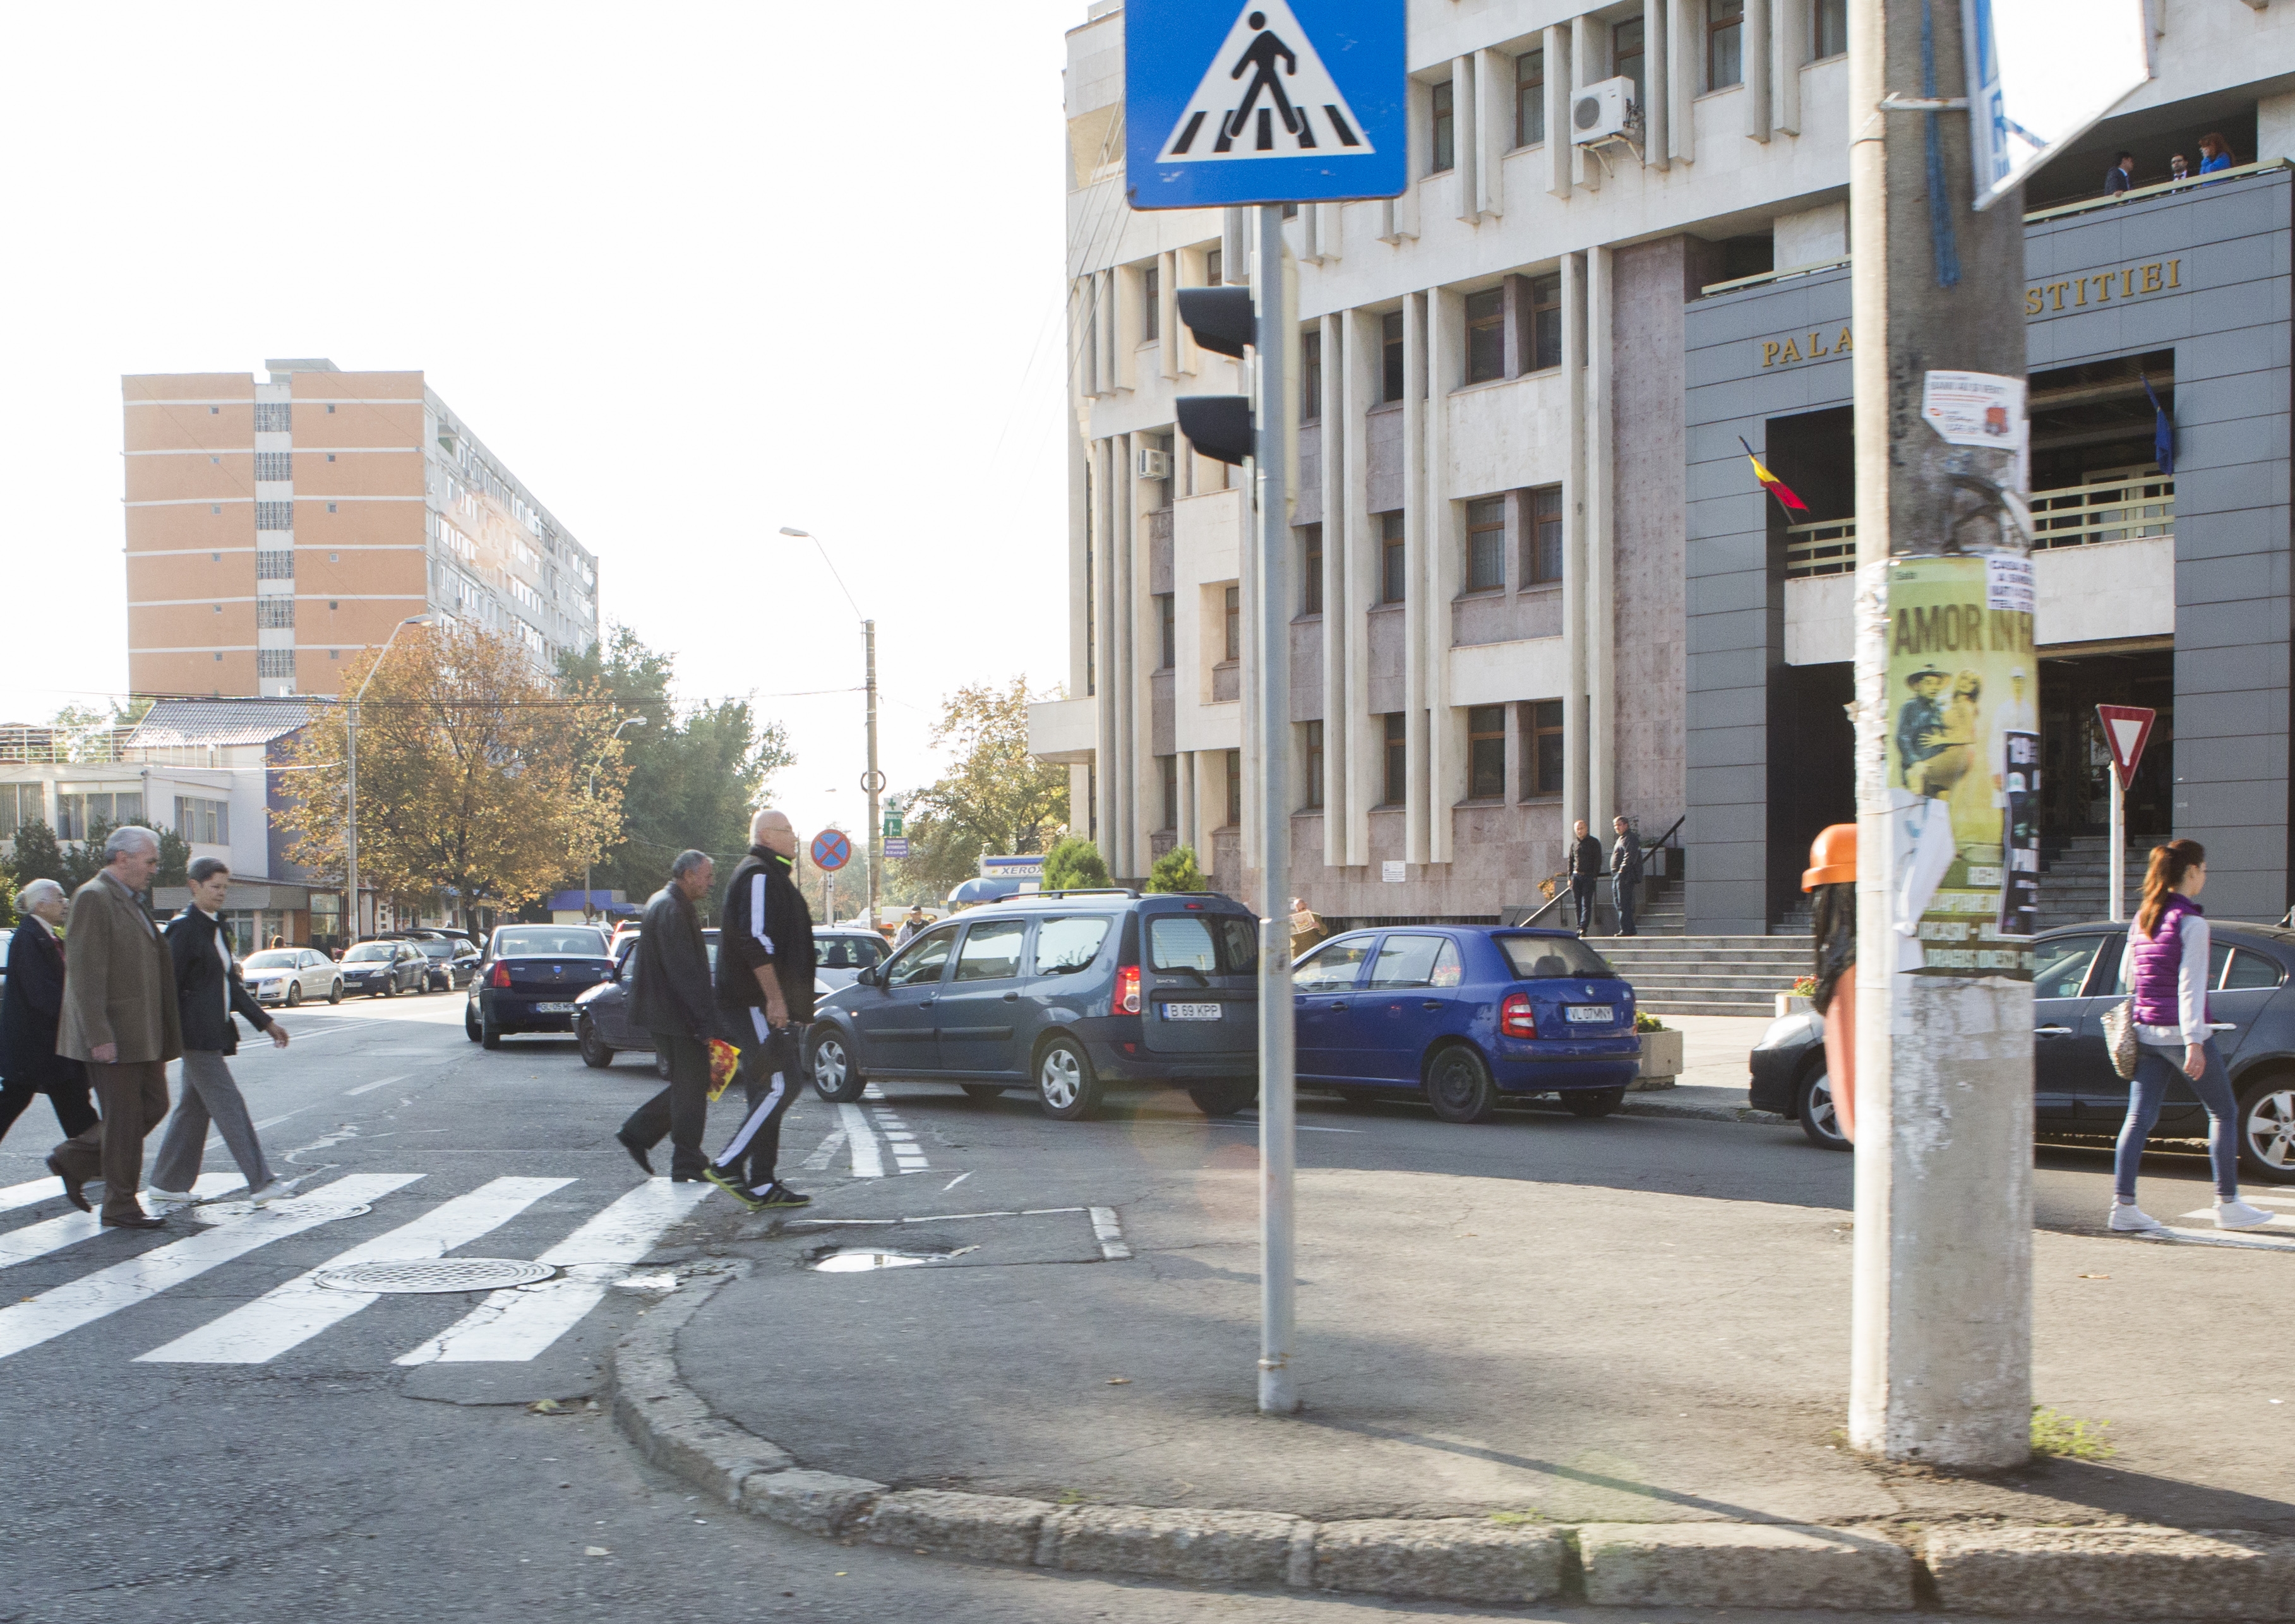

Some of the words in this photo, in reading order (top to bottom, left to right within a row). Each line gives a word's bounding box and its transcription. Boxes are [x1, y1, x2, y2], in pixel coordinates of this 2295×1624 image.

[2025, 259, 2181, 315] STITIEI
[1892, 604, 1983, 656] AMOR
[1001, 866, 1043, 875] XEROX
[1171, 1005, 1178, 1017] B
[1182, 1005, 1194, 1017] 69
[1197, 1005, 1218, 1017] KPP
